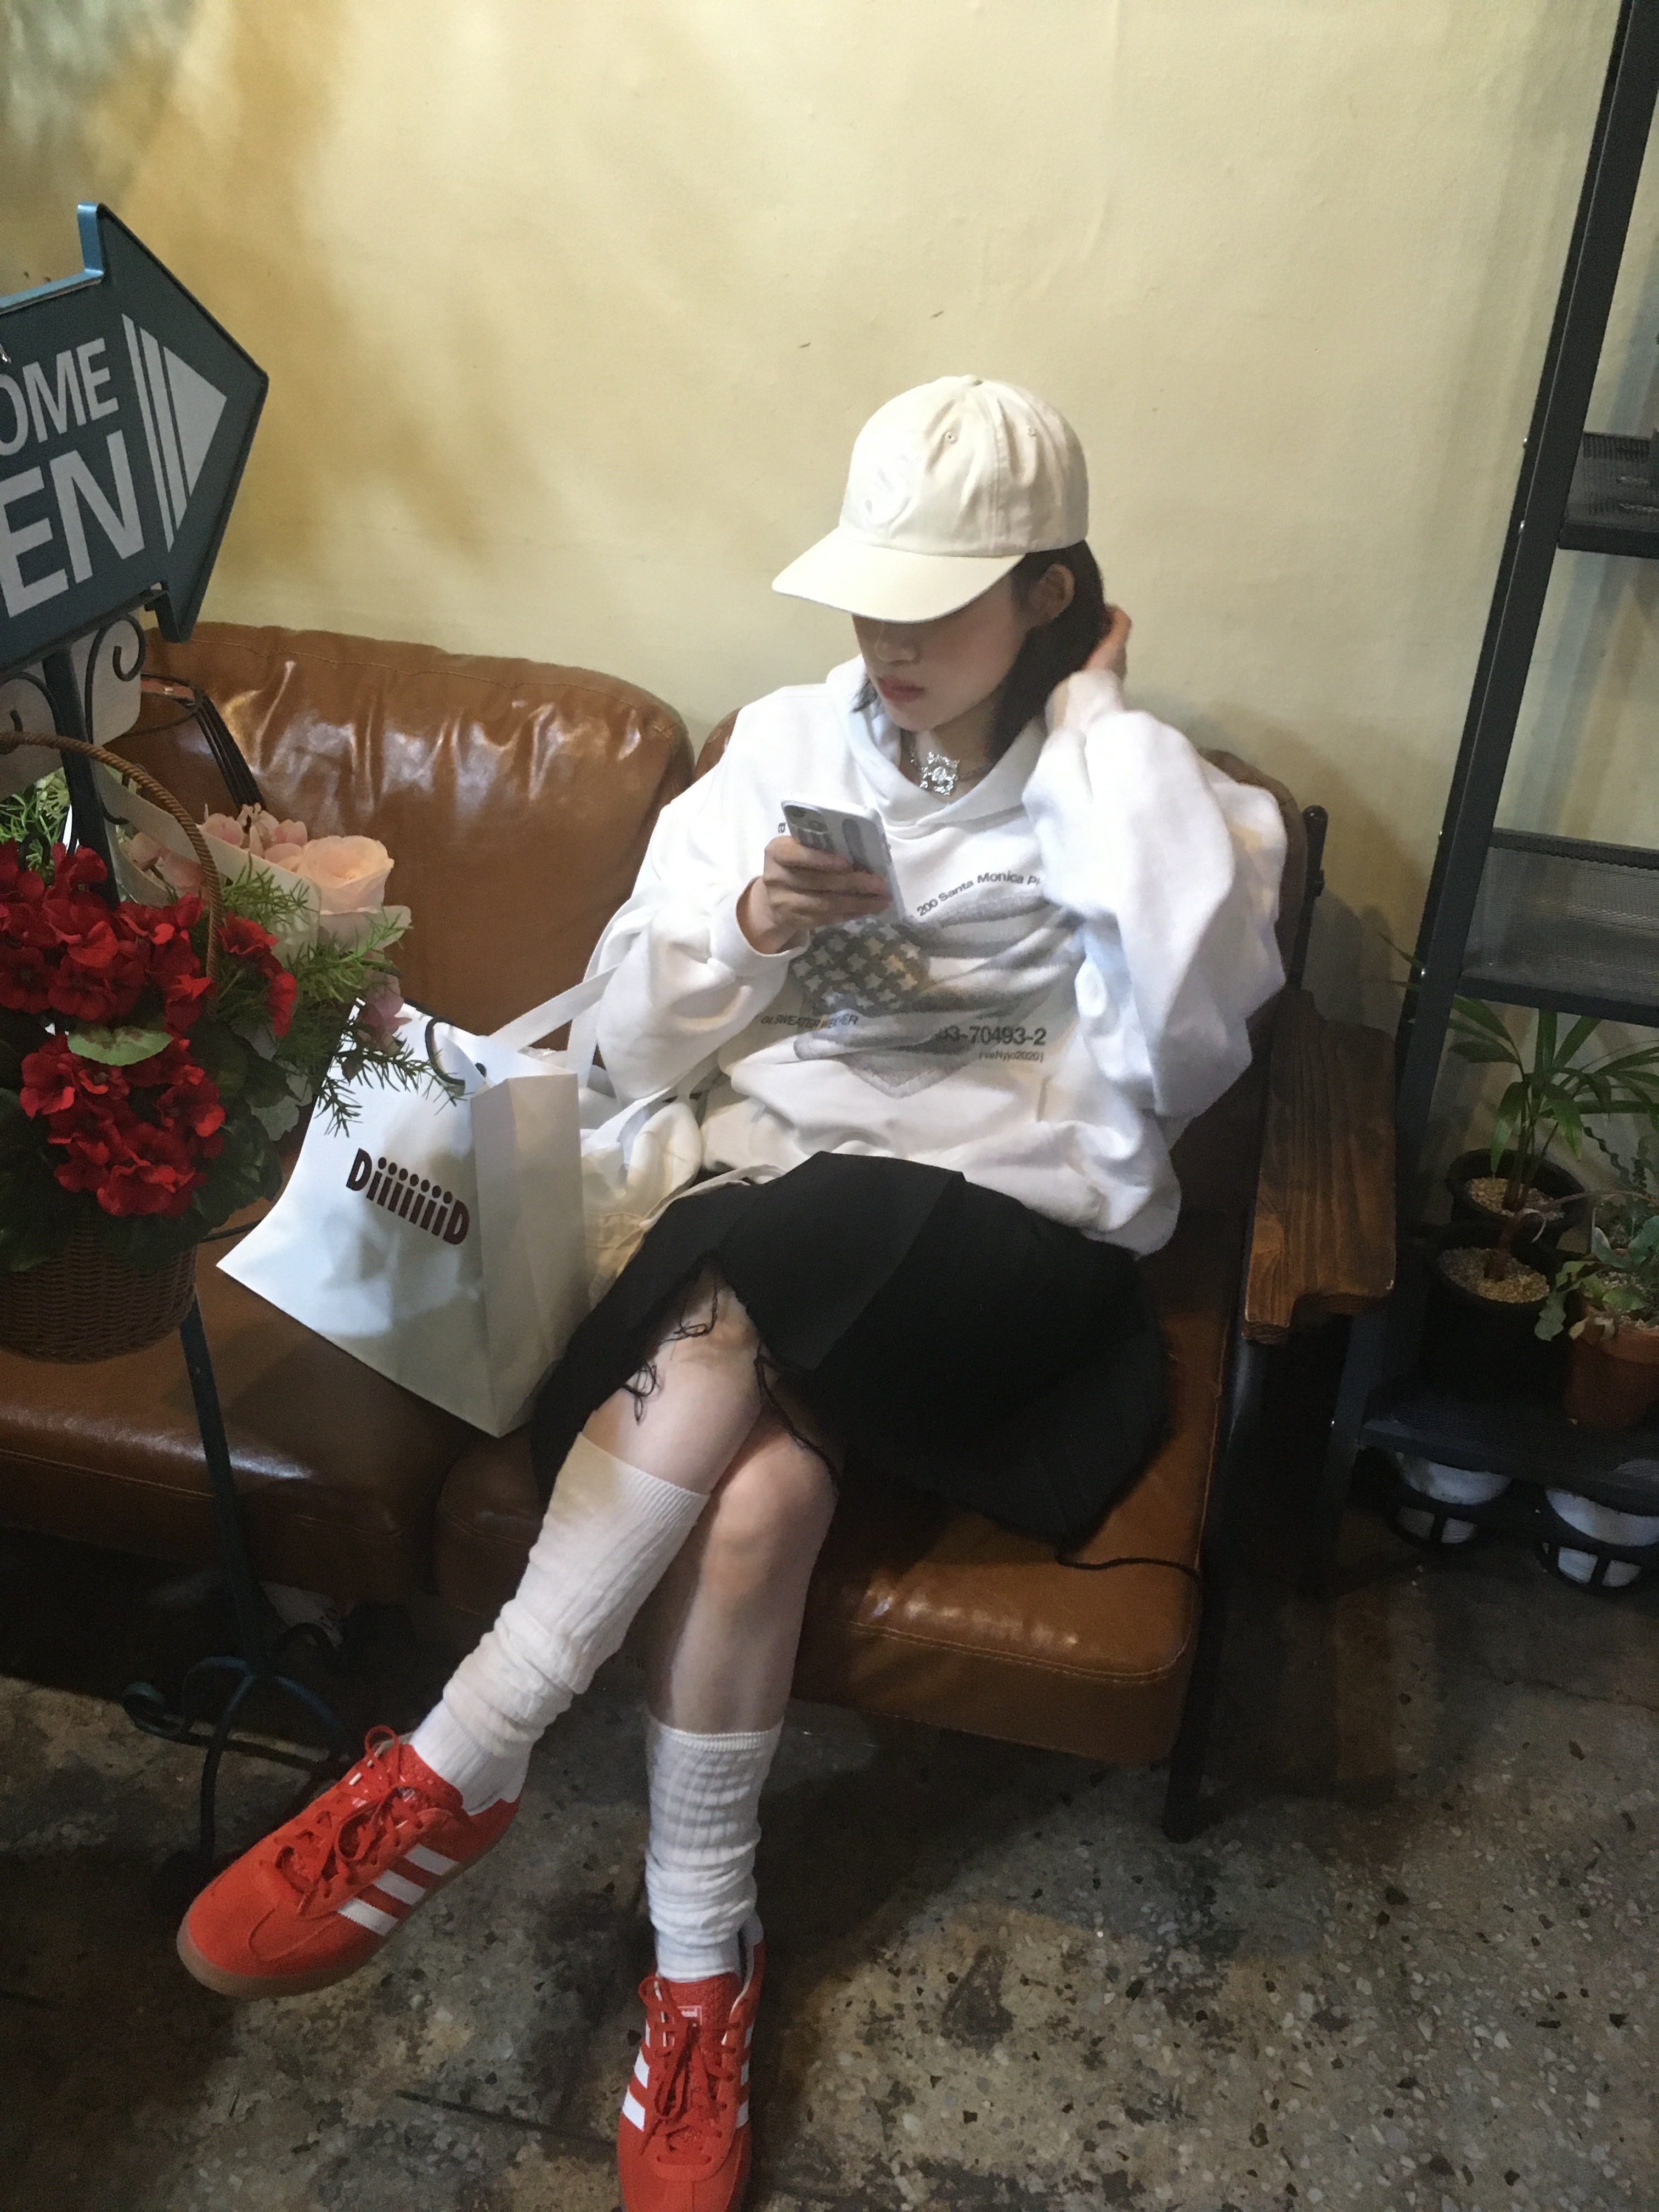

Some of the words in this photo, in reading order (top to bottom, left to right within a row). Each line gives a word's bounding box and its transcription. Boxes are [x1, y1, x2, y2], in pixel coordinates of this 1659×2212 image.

[0, 430, 145, 618] EN
[917, 898, 938, 916] 200
[938, 880, 974, 901] Santa
[977, 871, 1024, 884] Monica
